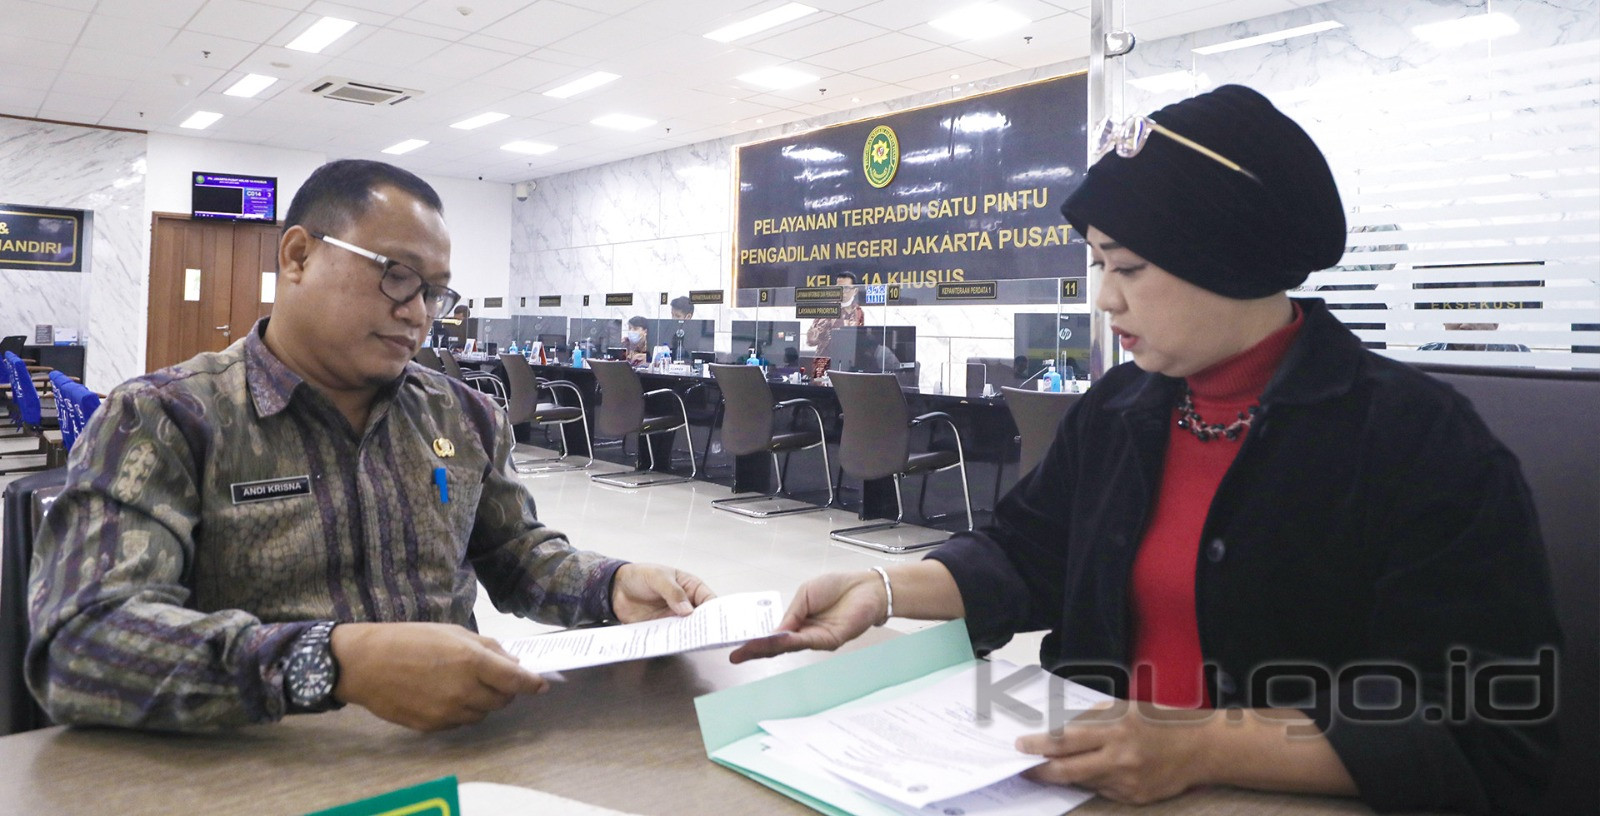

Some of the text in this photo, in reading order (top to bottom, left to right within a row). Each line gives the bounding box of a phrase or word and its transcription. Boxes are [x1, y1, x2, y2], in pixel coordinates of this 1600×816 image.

[753, 187, 1048, 236] PELAYANAN TERPADU SATU PINTU
[0, 221, 10, 235] &
[0, 239, 62, 254] ANDIRI
[740, 224, 1073, 265] PENGADILAN NEGERI JAKARTA PUSAT
[890, 287, 898, 298] 10
[1065, 282, 1076, 295] 11
[761, 291, 767, 301] 9
[1430, 301, 1524, 310] EKSEKUSI
[1060, 328, 1072, 340] hp
[243, 482, 302, 497] ANDI KRISNA
